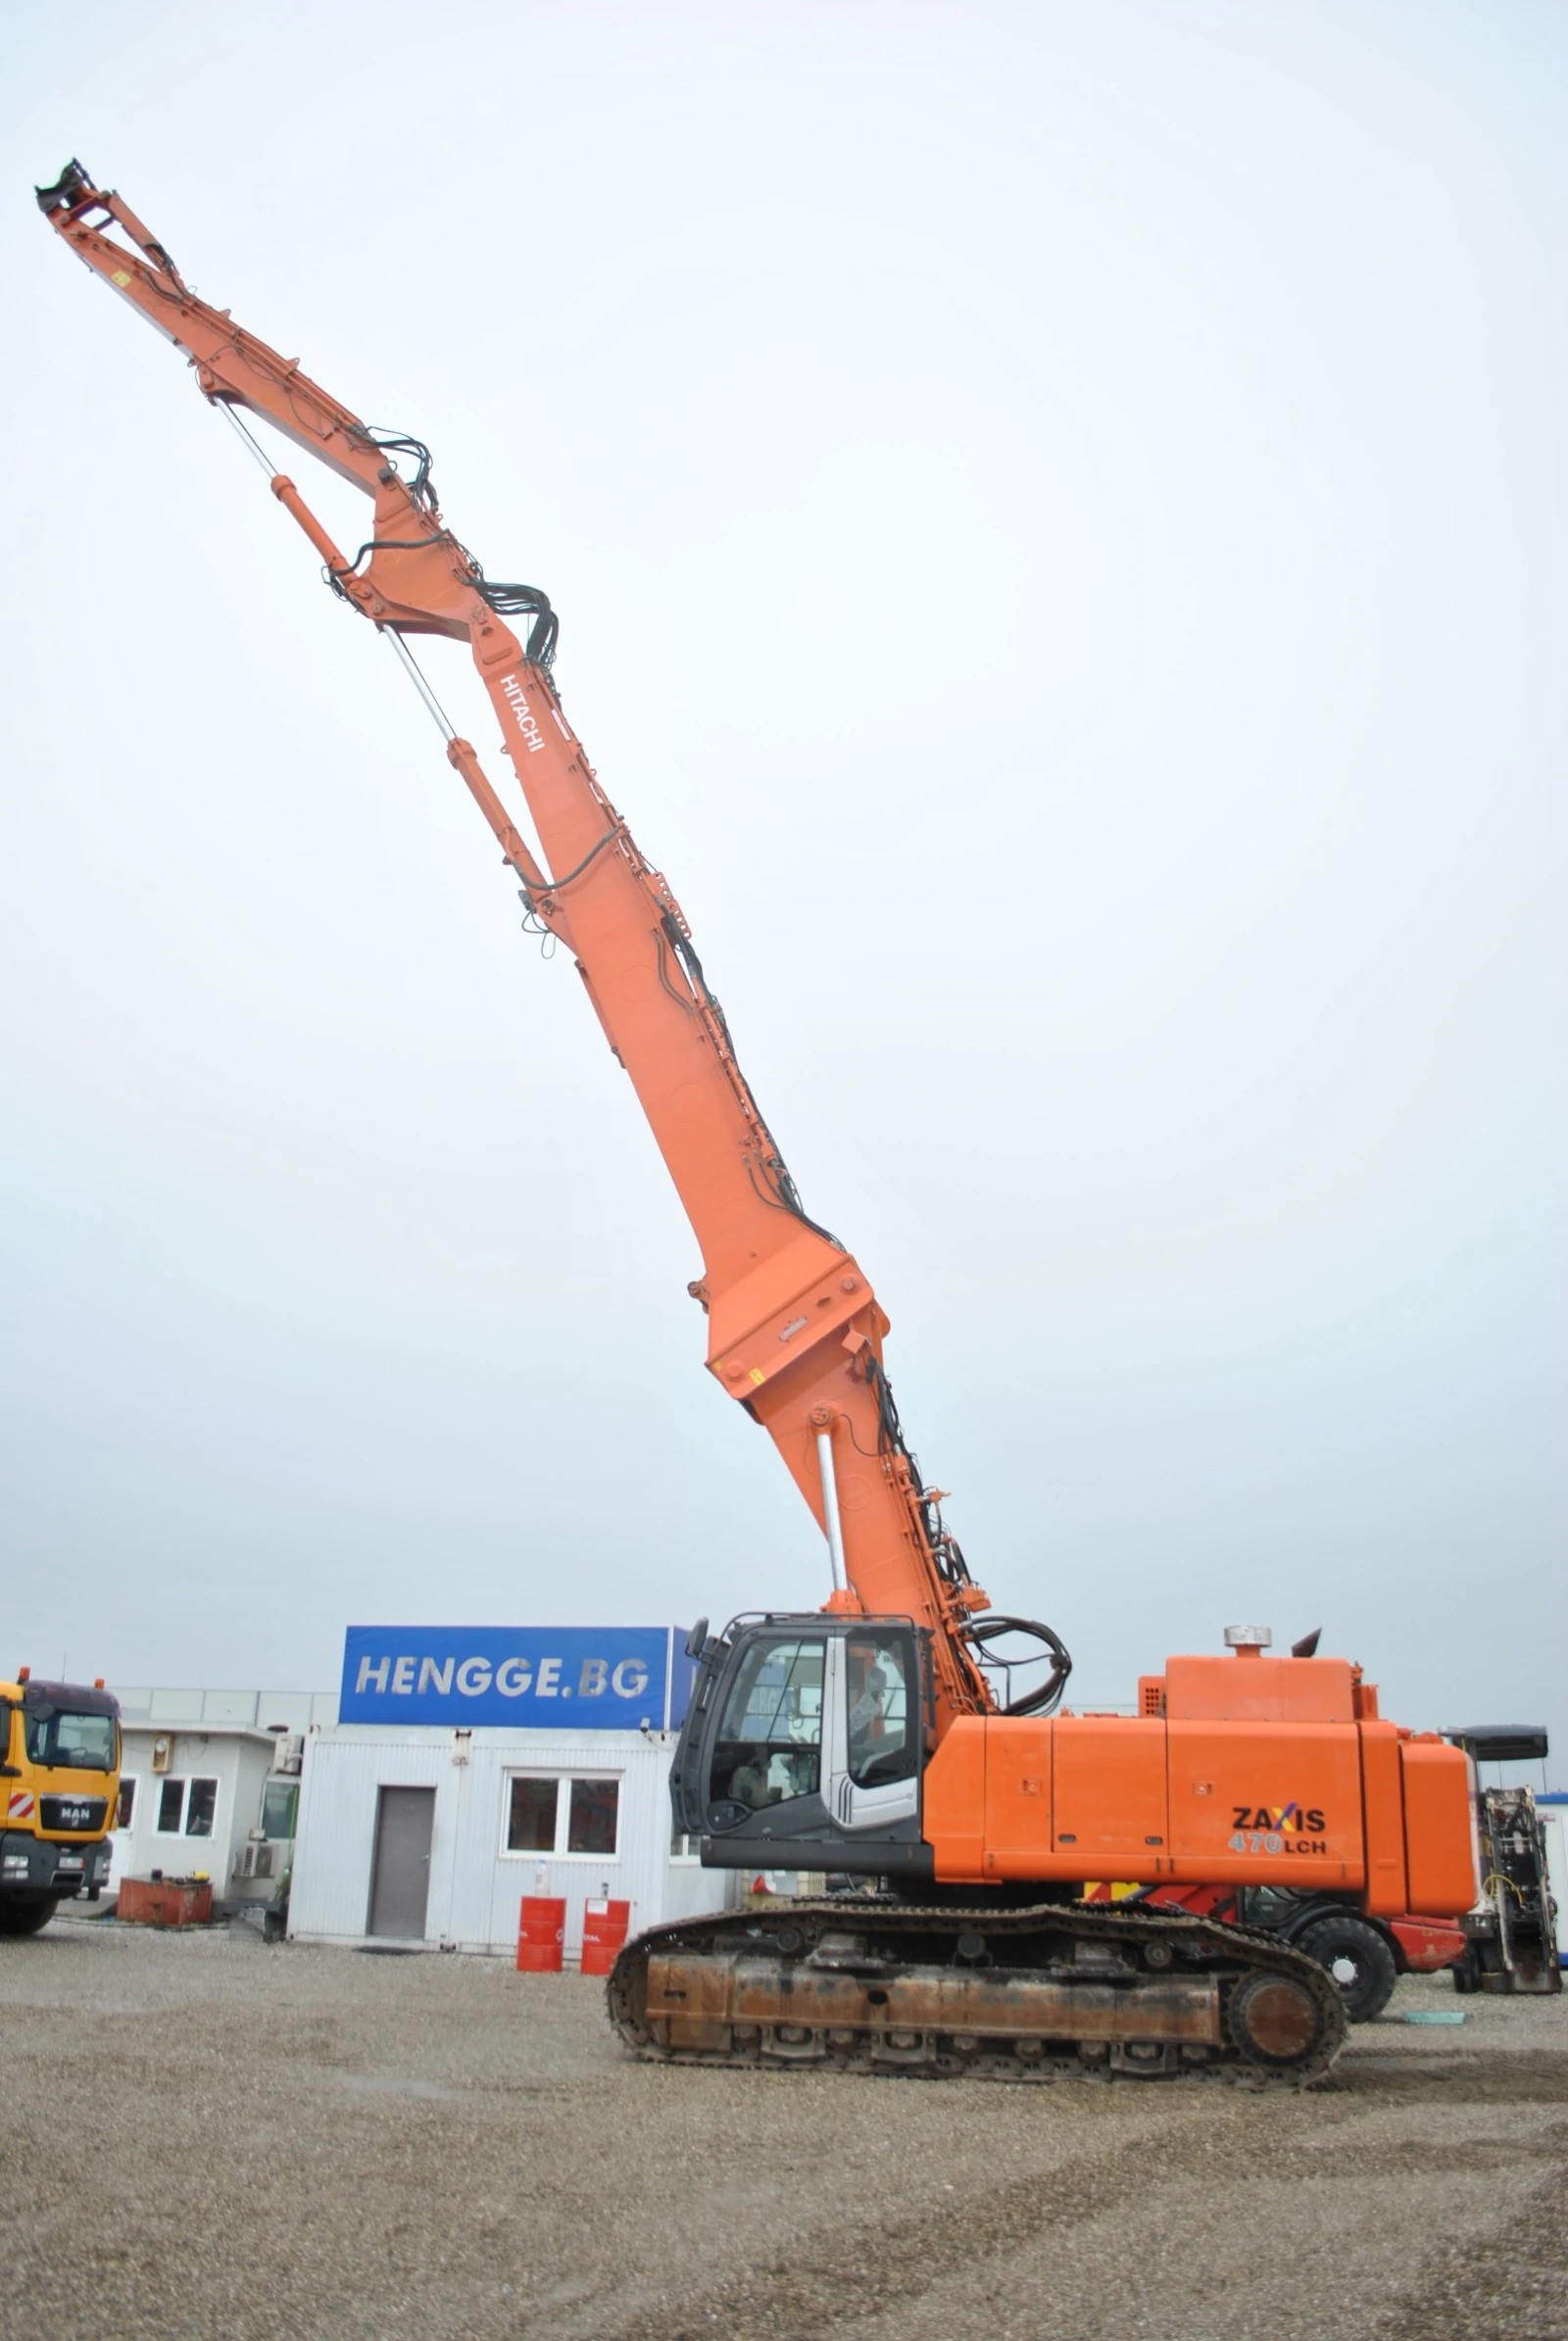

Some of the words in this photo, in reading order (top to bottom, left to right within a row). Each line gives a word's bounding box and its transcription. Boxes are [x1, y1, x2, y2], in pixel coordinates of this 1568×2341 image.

[501, 674, 546, 753] HITACHI
[355, 1656, 649, 1699] HENGGE.BG
[61, 1807, 90, 1819] MAN
[1232, 1801, 1326, 1832] ZAXIS
